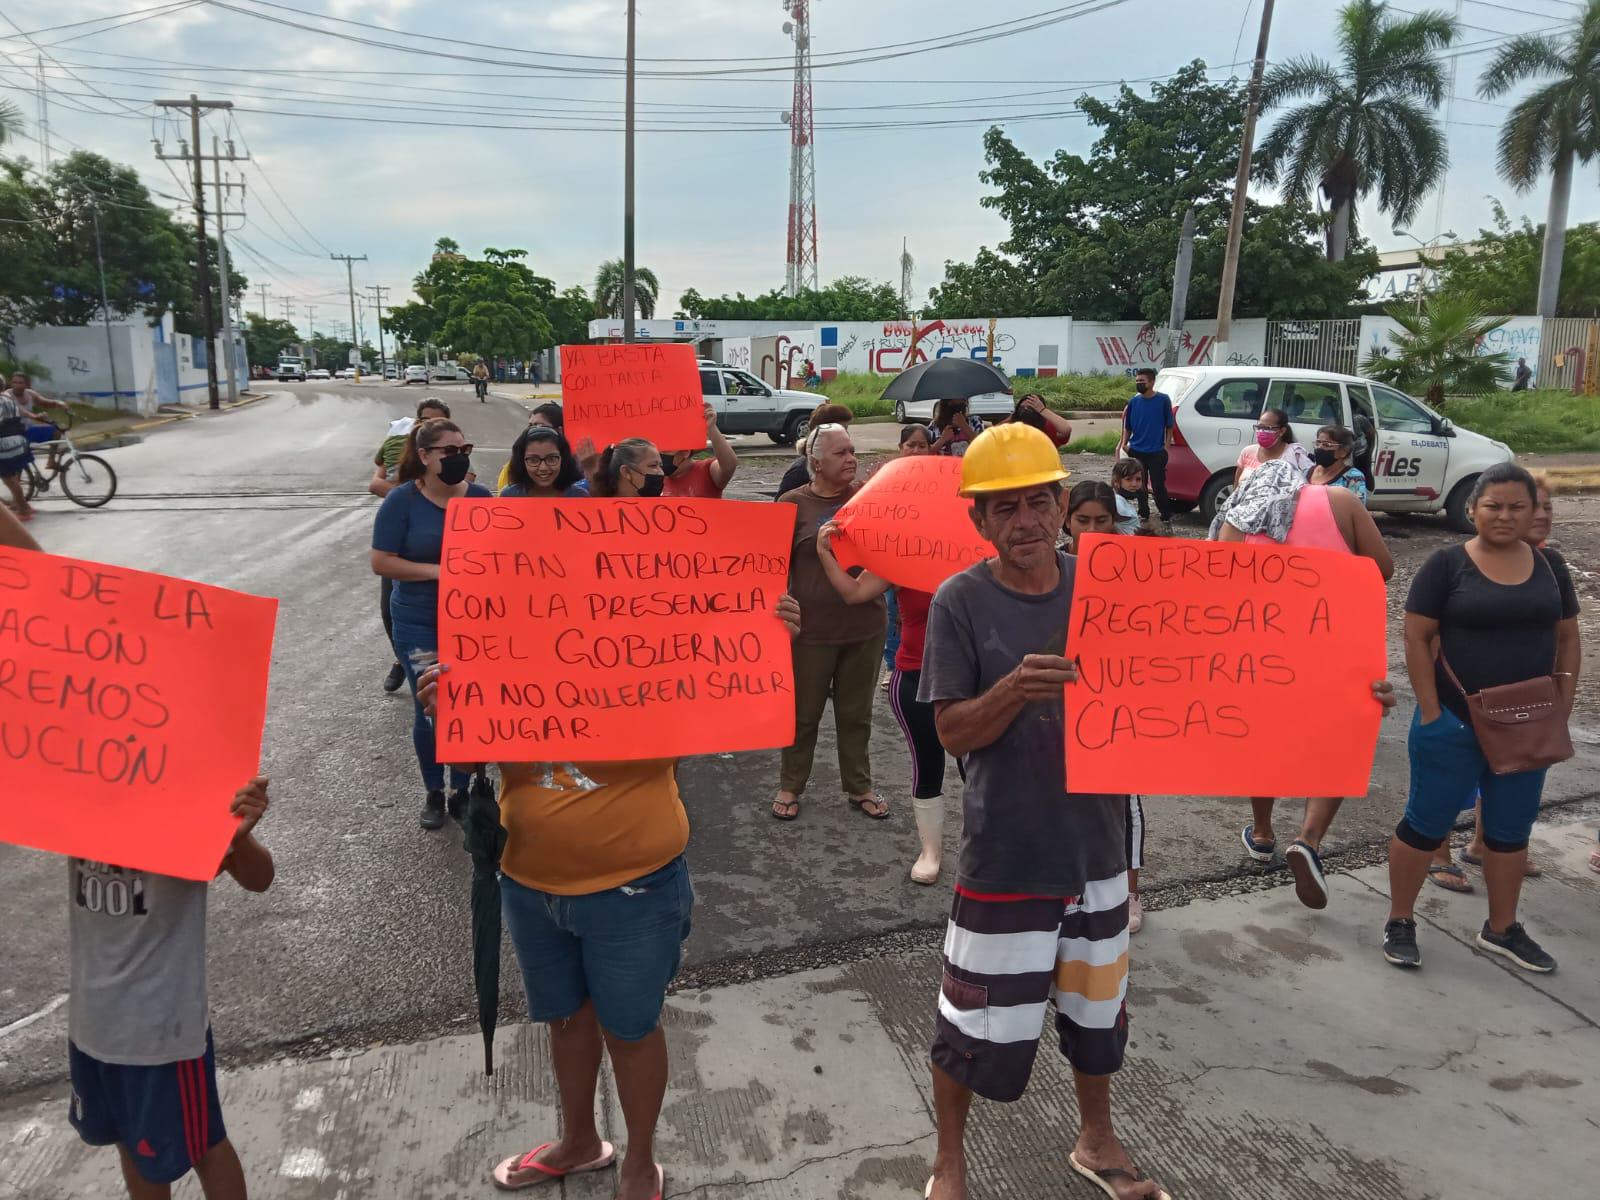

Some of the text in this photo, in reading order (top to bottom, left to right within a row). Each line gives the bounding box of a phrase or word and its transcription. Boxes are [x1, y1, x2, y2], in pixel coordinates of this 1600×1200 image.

[565, 346, 666, 369] YA BASTA
[564, 369, 663, 391] CON TANTA
[450, 501, 707, 535] LOS NIÑOS
[446, 547, 788, 580] ESTAN ATEMORIZADOS
[1088, 540, 1321, 588] QUEREMOS
[59, 564, 121, 605] DE
[154, 584, 214, 629] LA
[445, 587, 767, 621] CON LA PRESENCIA
[1078, 596, 1331, 637] REGRESAR A
[452, 633, 529, 662] DEL
[1074, 653, 1296, 694] NUESTRAS
[447, 671, 792, 711] YA NO QUIEREN SALIR
[447, 718, 464, 743] A
[1075, 699, 1250, 750] CASAS
